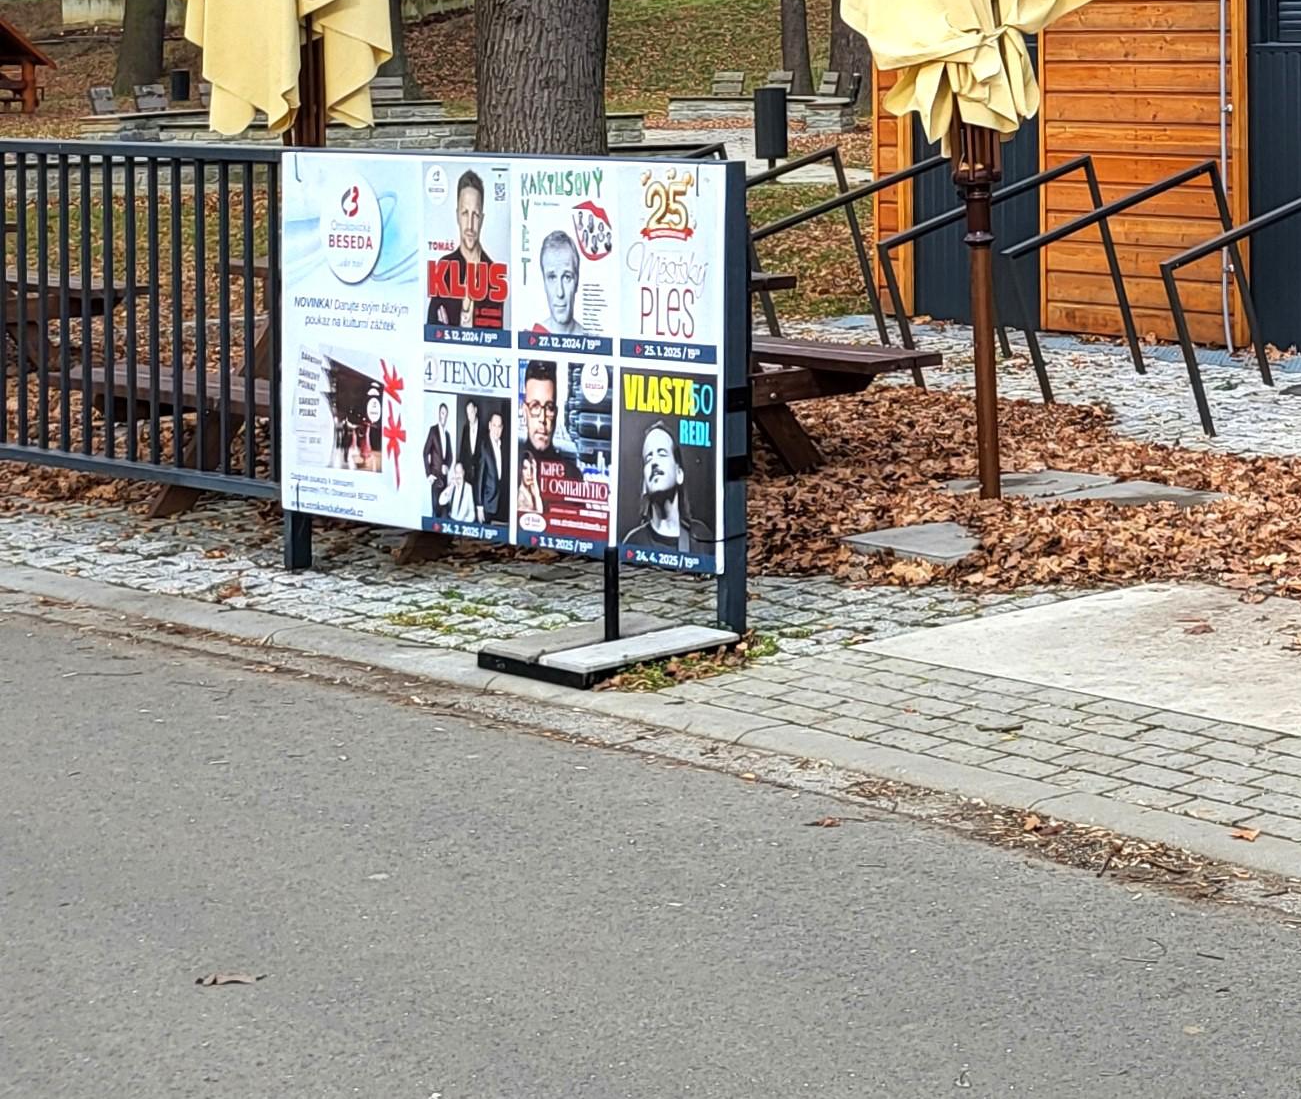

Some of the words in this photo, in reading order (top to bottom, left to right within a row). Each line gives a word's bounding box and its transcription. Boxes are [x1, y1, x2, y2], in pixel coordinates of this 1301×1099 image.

[645, 181, 689, 229] 25
[328, 234, 373, 250] BESEDA
[428, 240, 455, 252] TOMÁŠ
[427, 259, 509, 302] KLUS
[294, 296, 334, 309] NOVINKA!
[462, 331, 479, 342] 2024
[562, 338, 582, 349] 2024
[664, 346, 682, 358] 2025
[424, 360, 432, 381] 4
[440, 357, 512, 389] TENOŘI
[623, 373, 696, 416] VLASTA
[679, 419, 712, 448] REDL
[555, 538, 574, 551] 2025
[659, 552, 678, 566] 2025
